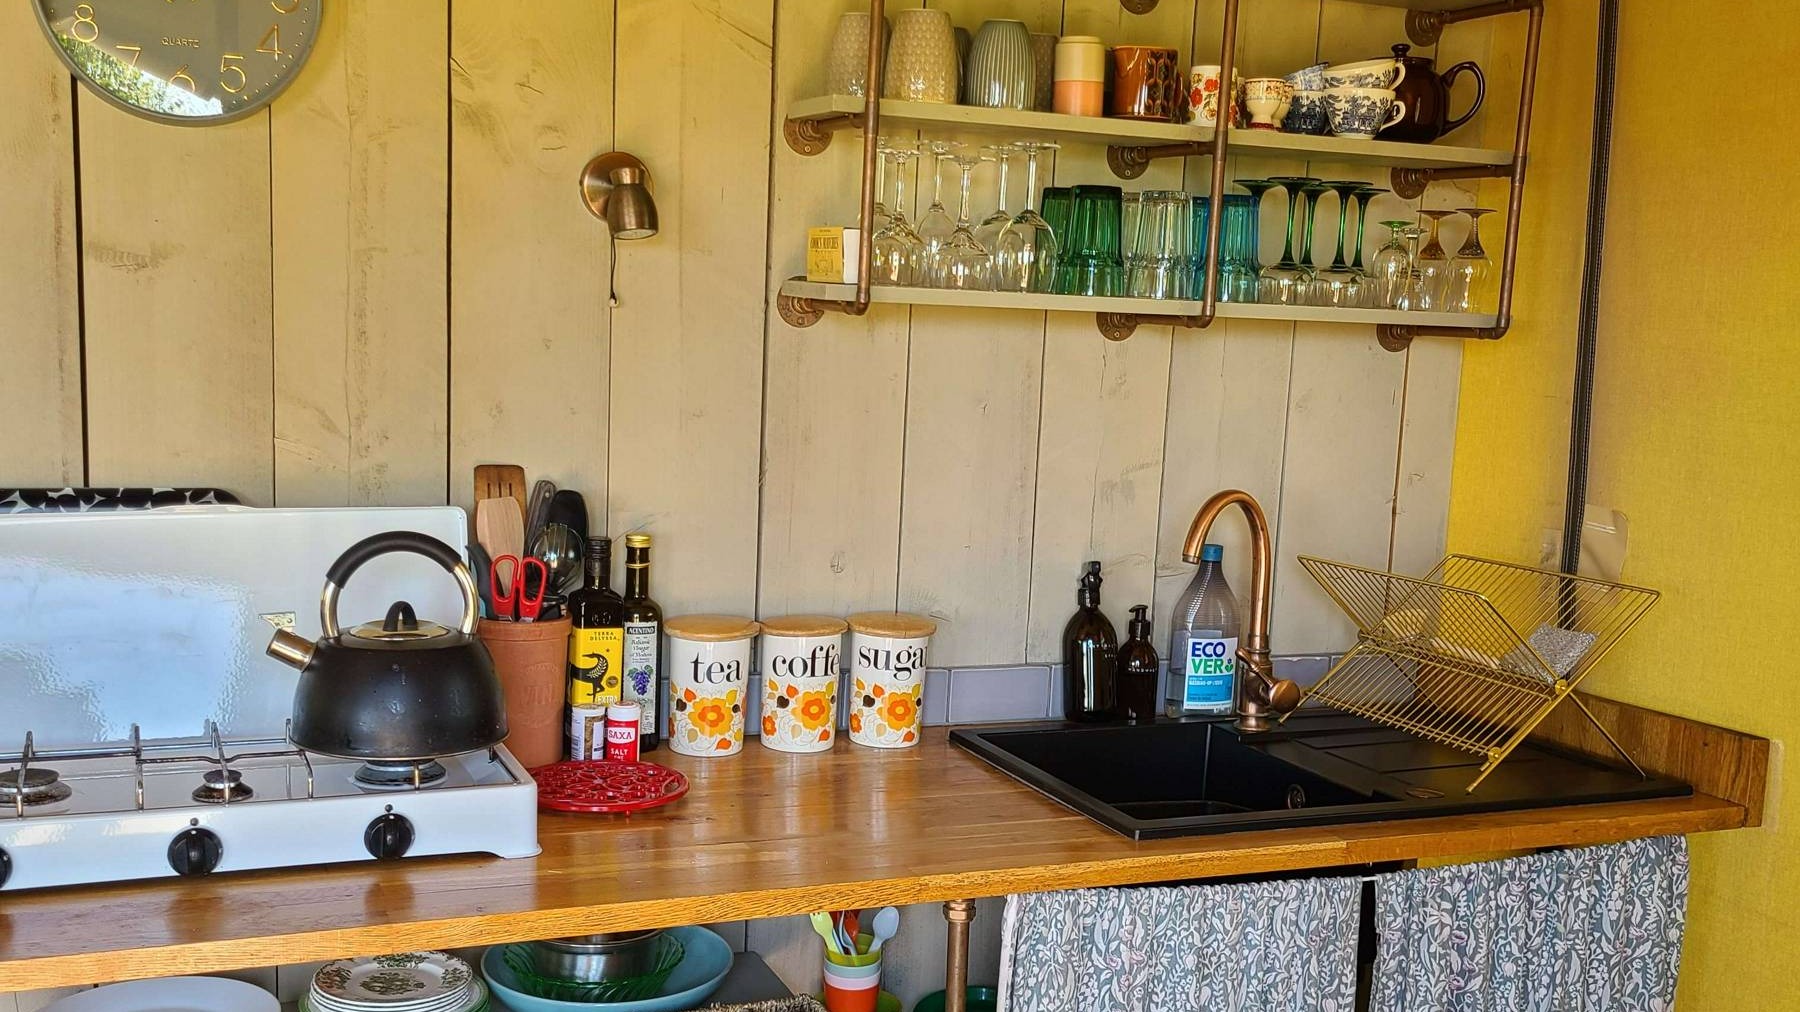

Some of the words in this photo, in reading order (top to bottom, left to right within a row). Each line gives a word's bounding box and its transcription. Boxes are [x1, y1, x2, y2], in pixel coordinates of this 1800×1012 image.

[71, 3, 99, 43] 8
[161, 36, 200, 49] QUARTZ
[256, 23, 284, 62] 4
[115, 45, 142, 67] 7
[220, 54, 246, 93] 5
[772, 643, 840, 678] coffe
[1191, 641, 1226, 658] ECO
[690, 651, 743, 684] tea
[1191, 658, 1224, 674] VER
[608, 730, 633, 740] SAXA
[610, 748, 629, 756] SALT
